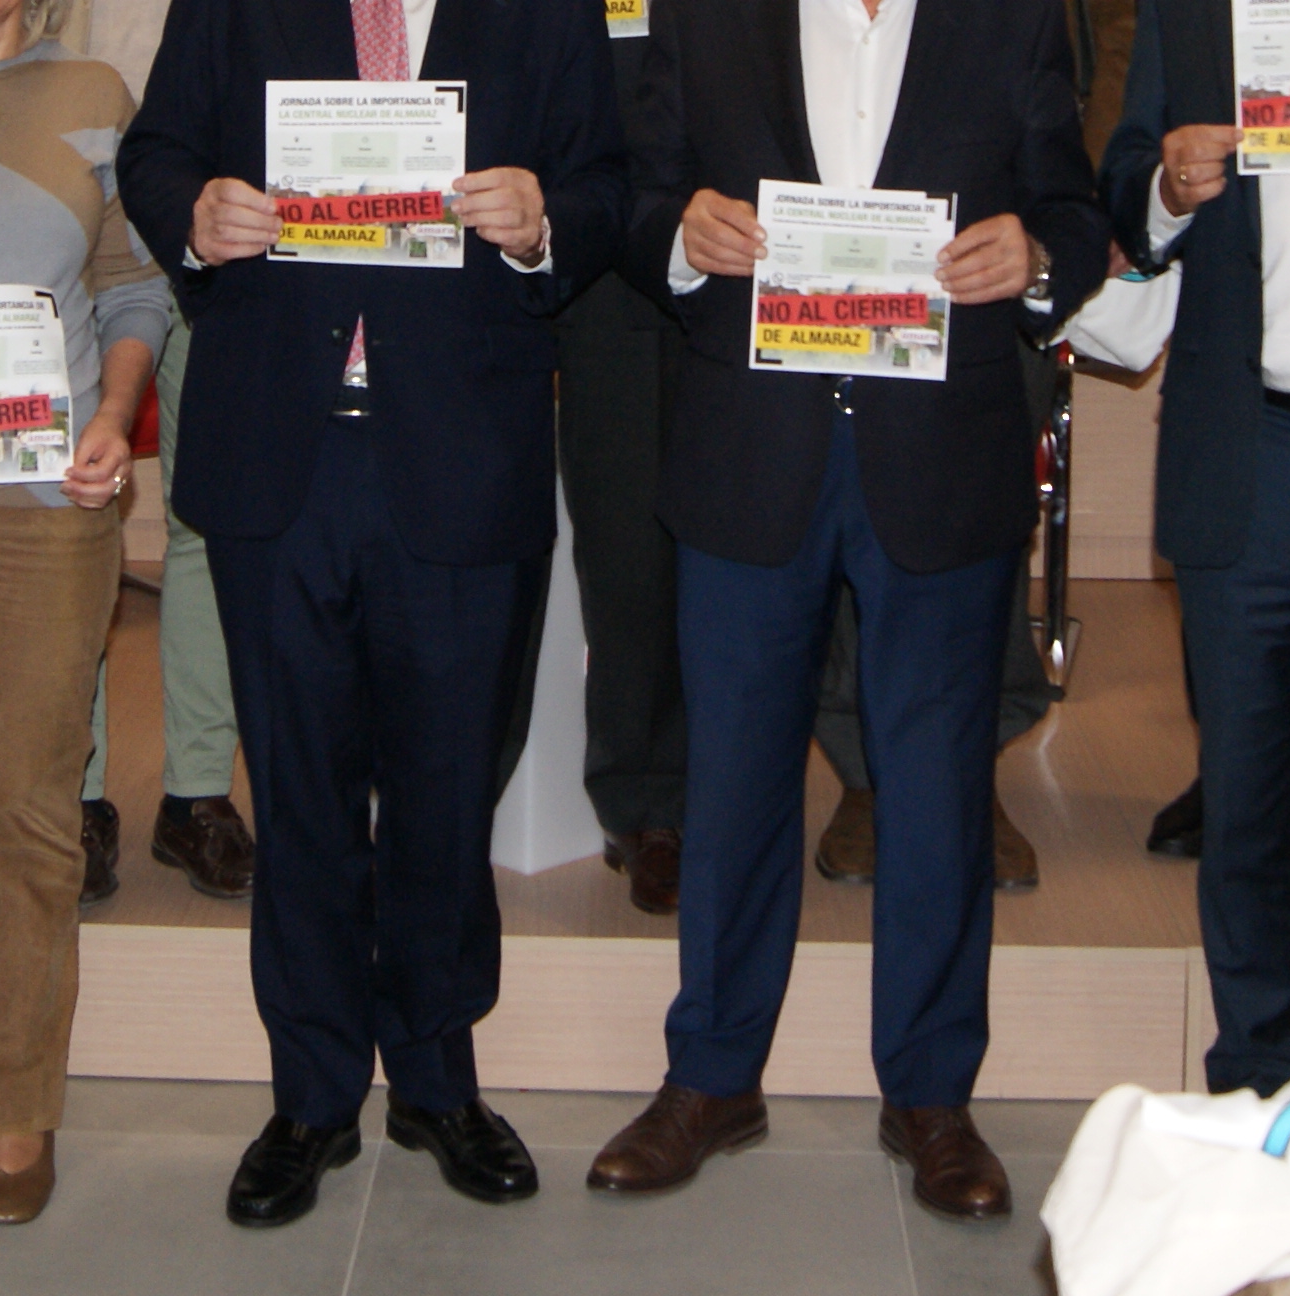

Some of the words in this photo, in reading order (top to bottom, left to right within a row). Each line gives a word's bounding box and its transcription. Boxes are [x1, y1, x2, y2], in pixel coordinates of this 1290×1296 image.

[311, 204, 339, 222] AL
[347, 195, 439, 220] CIERRE!
[304, 228, 376, 242] ALMARAZ
[759, 301, 791, 323] NO
[798, 301, 826, 321] AL
[834, 298, 924, 321] CIERRE!
[763, 330, 781, 343] DE
[791, 331, 861, 347] ALMARAZ
